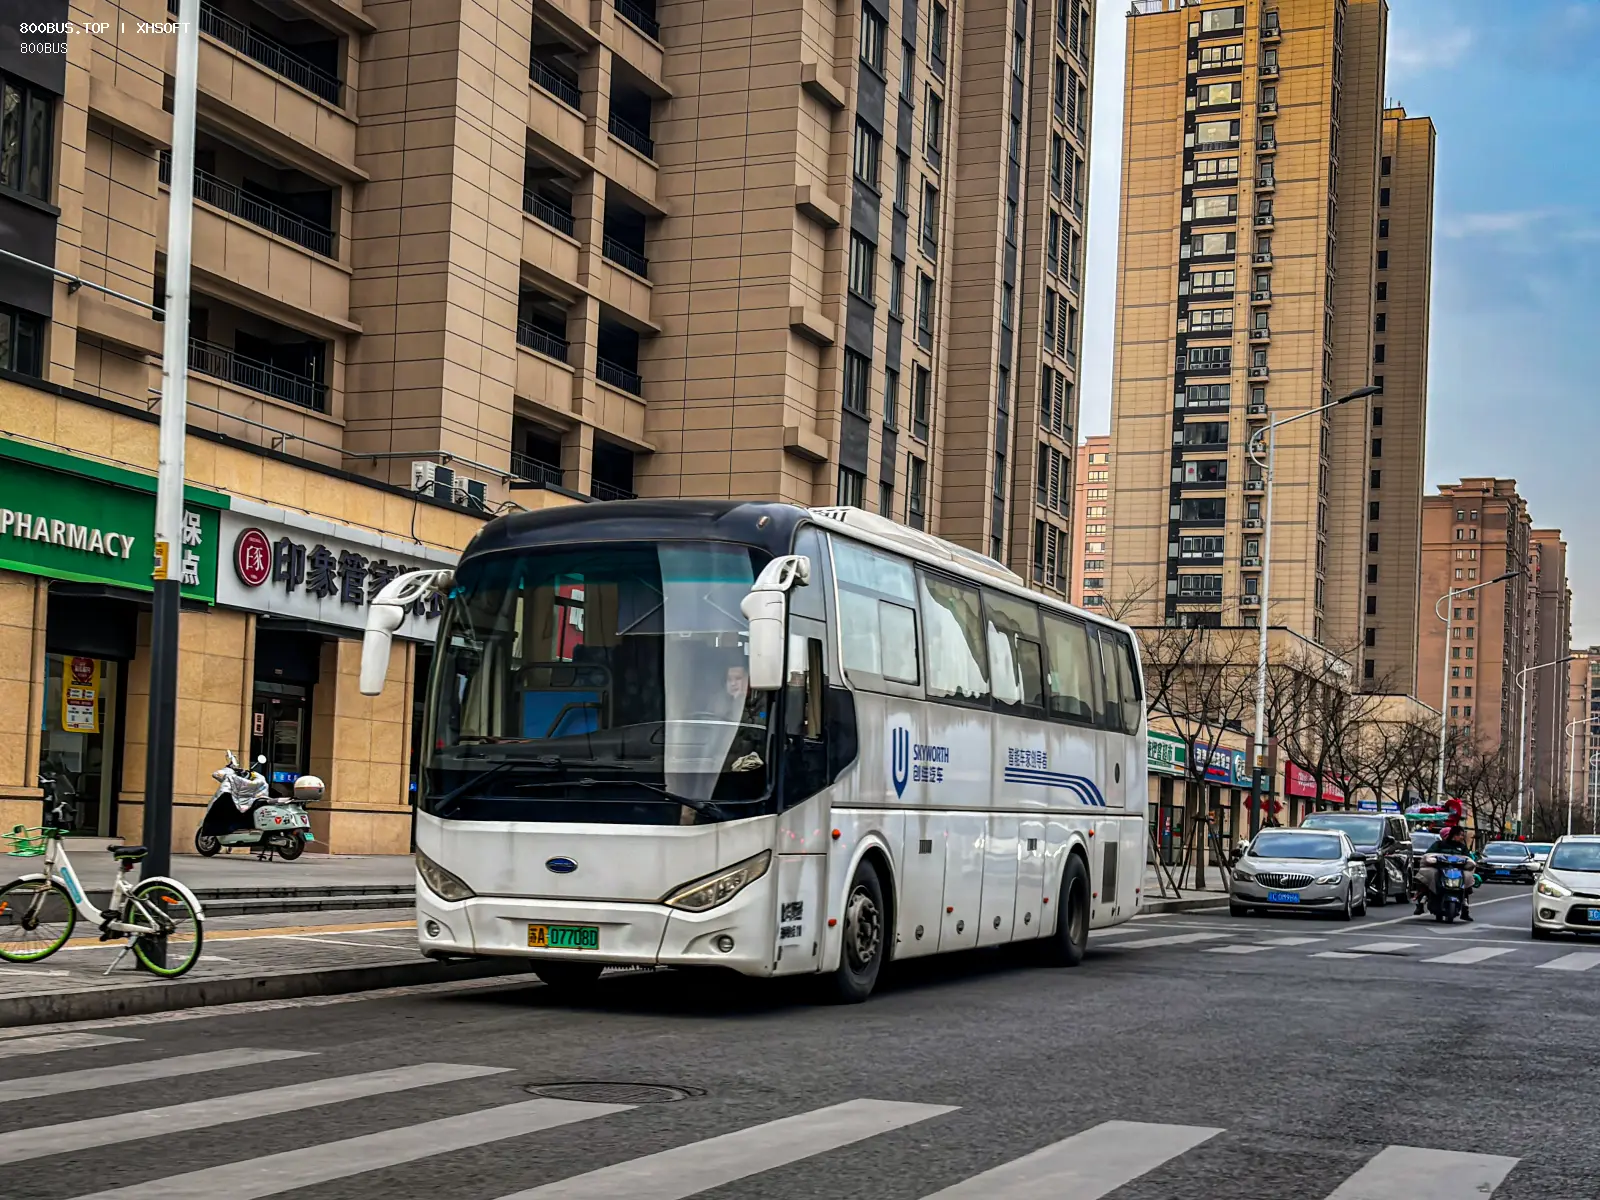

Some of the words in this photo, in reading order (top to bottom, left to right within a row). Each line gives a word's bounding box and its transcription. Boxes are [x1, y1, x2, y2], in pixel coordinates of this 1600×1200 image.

[0, 508, 135, 559] PHARMACY
[913, 743, 949, 763] SKYWORTH
[913, 764, 943, 783] 创维汽车
